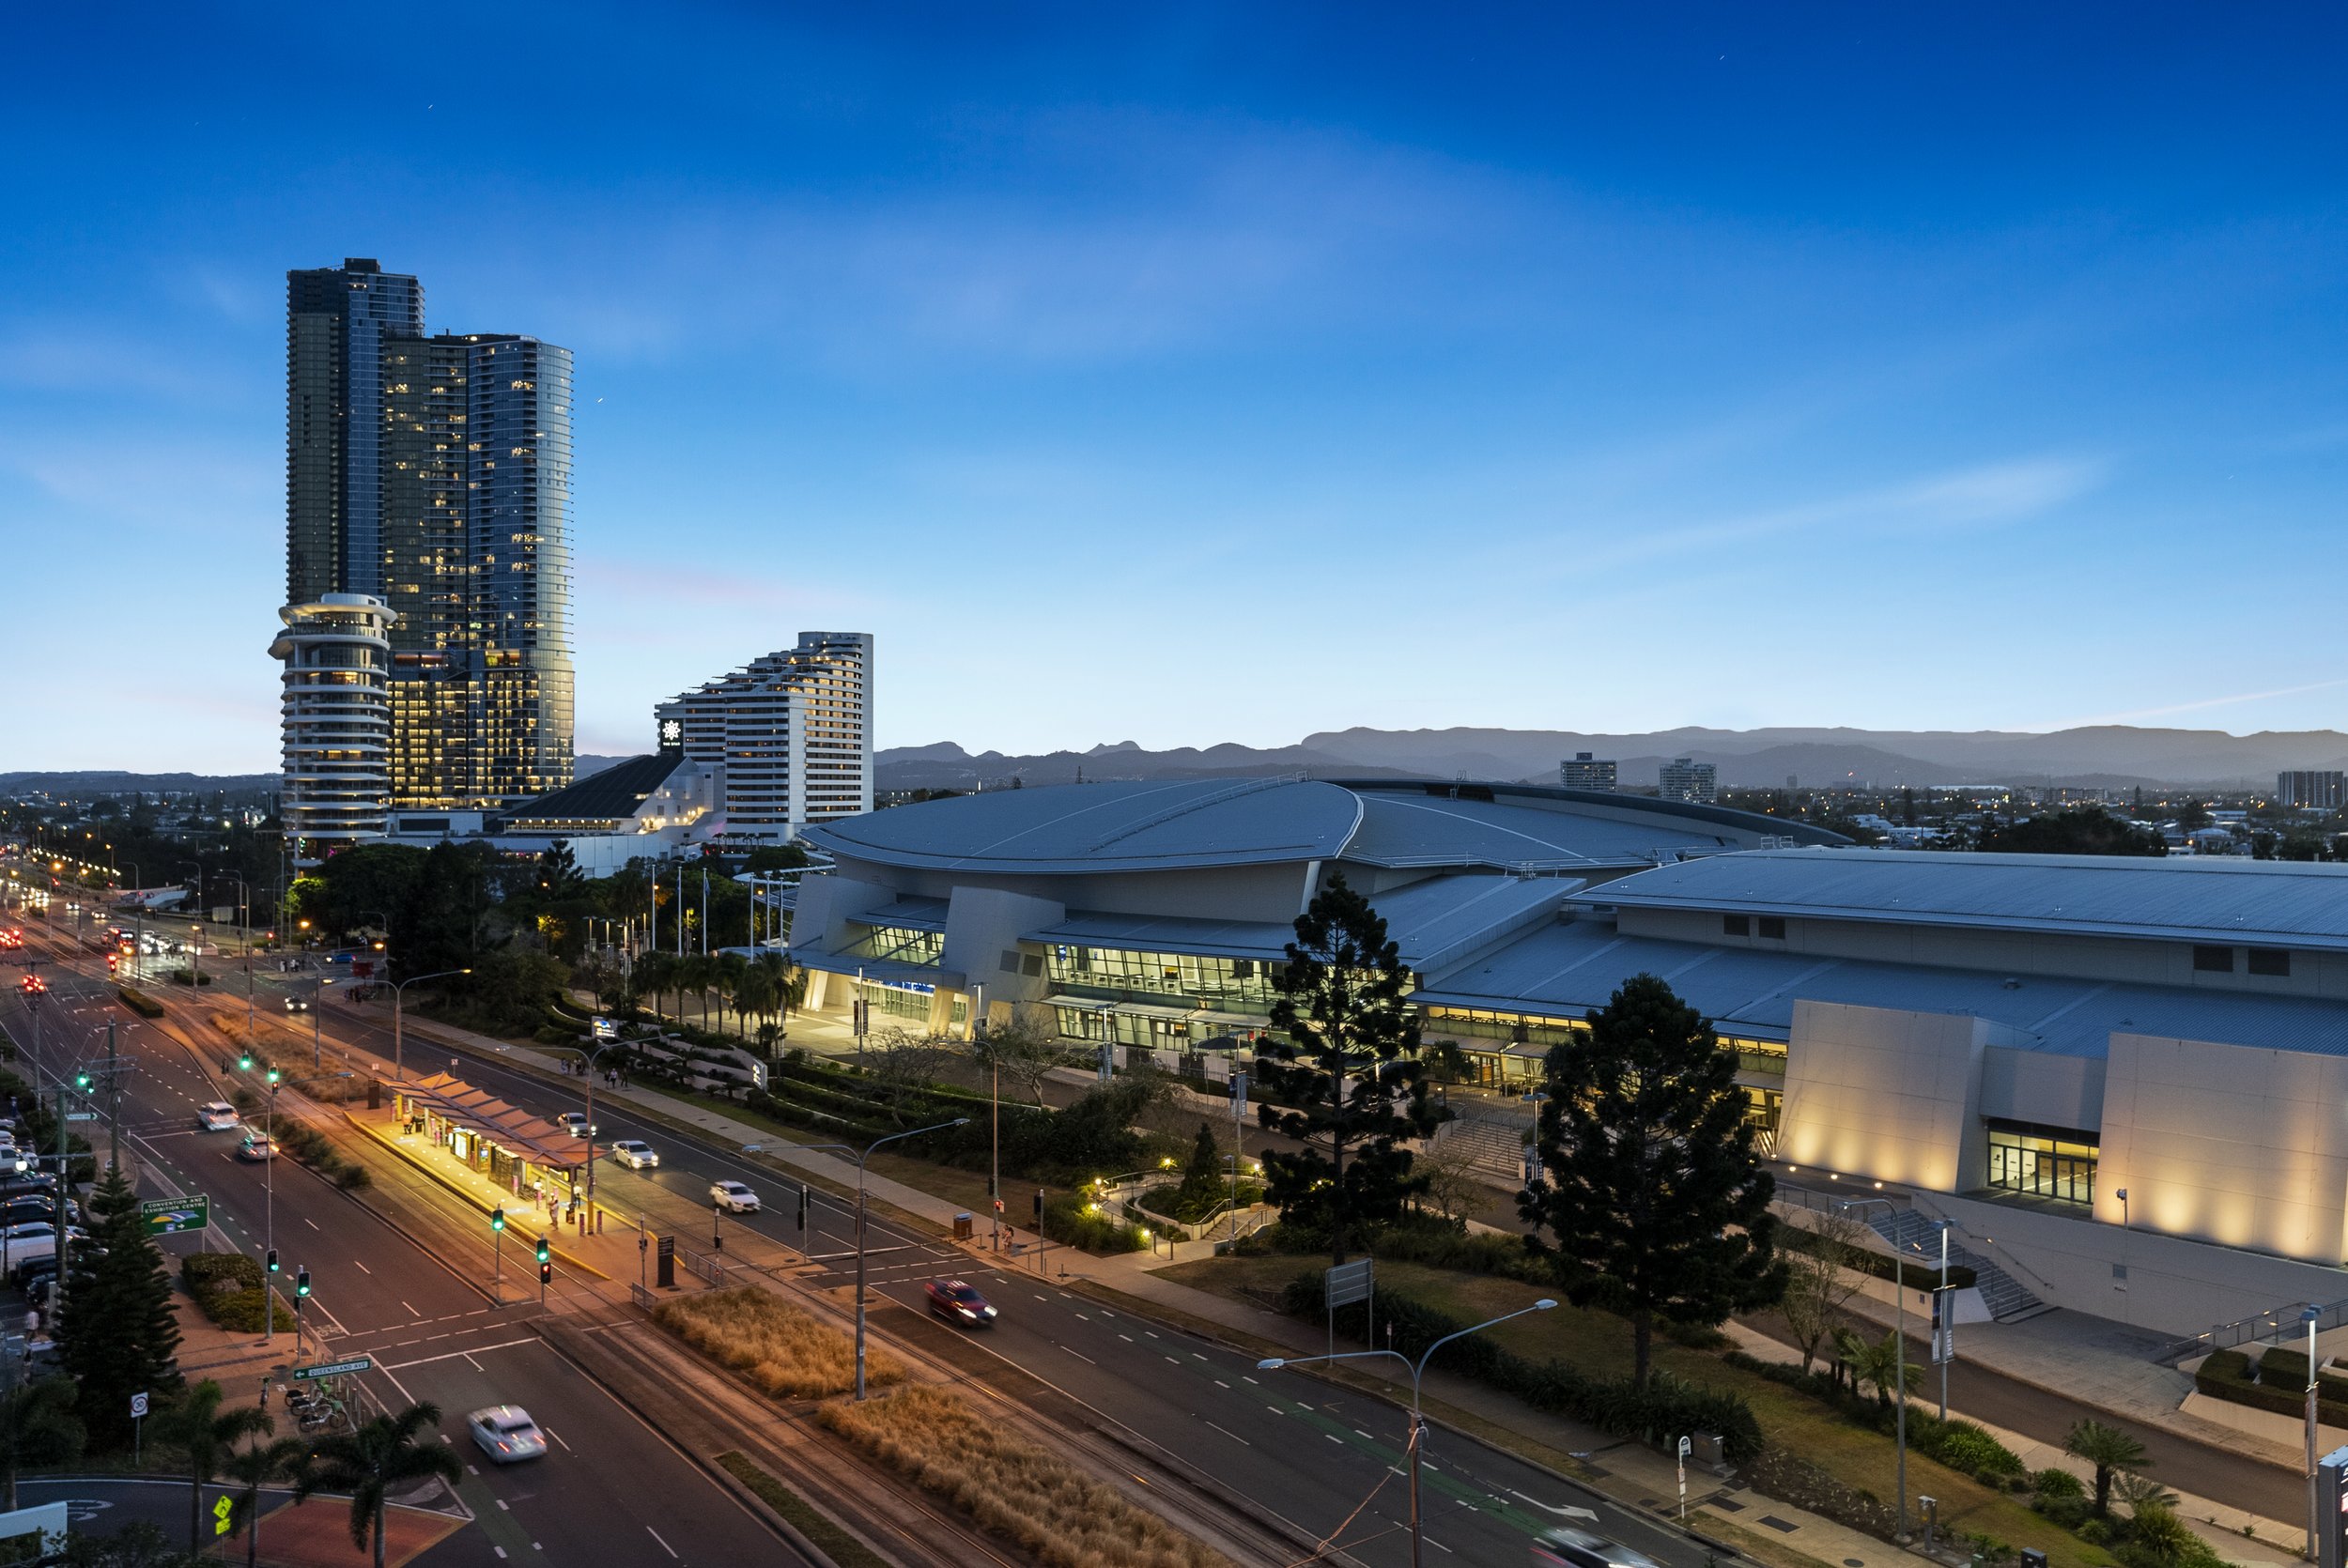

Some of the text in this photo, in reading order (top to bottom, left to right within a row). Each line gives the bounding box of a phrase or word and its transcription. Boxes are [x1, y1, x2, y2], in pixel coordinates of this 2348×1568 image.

[147, 1199, 187, 1208] CONVENTION
[144, 1206, 179, 1214] EXHIBITION
[310, 1363, 352, 1376] QUEENSLAND
[135, 1400, 144, 1409] 30
